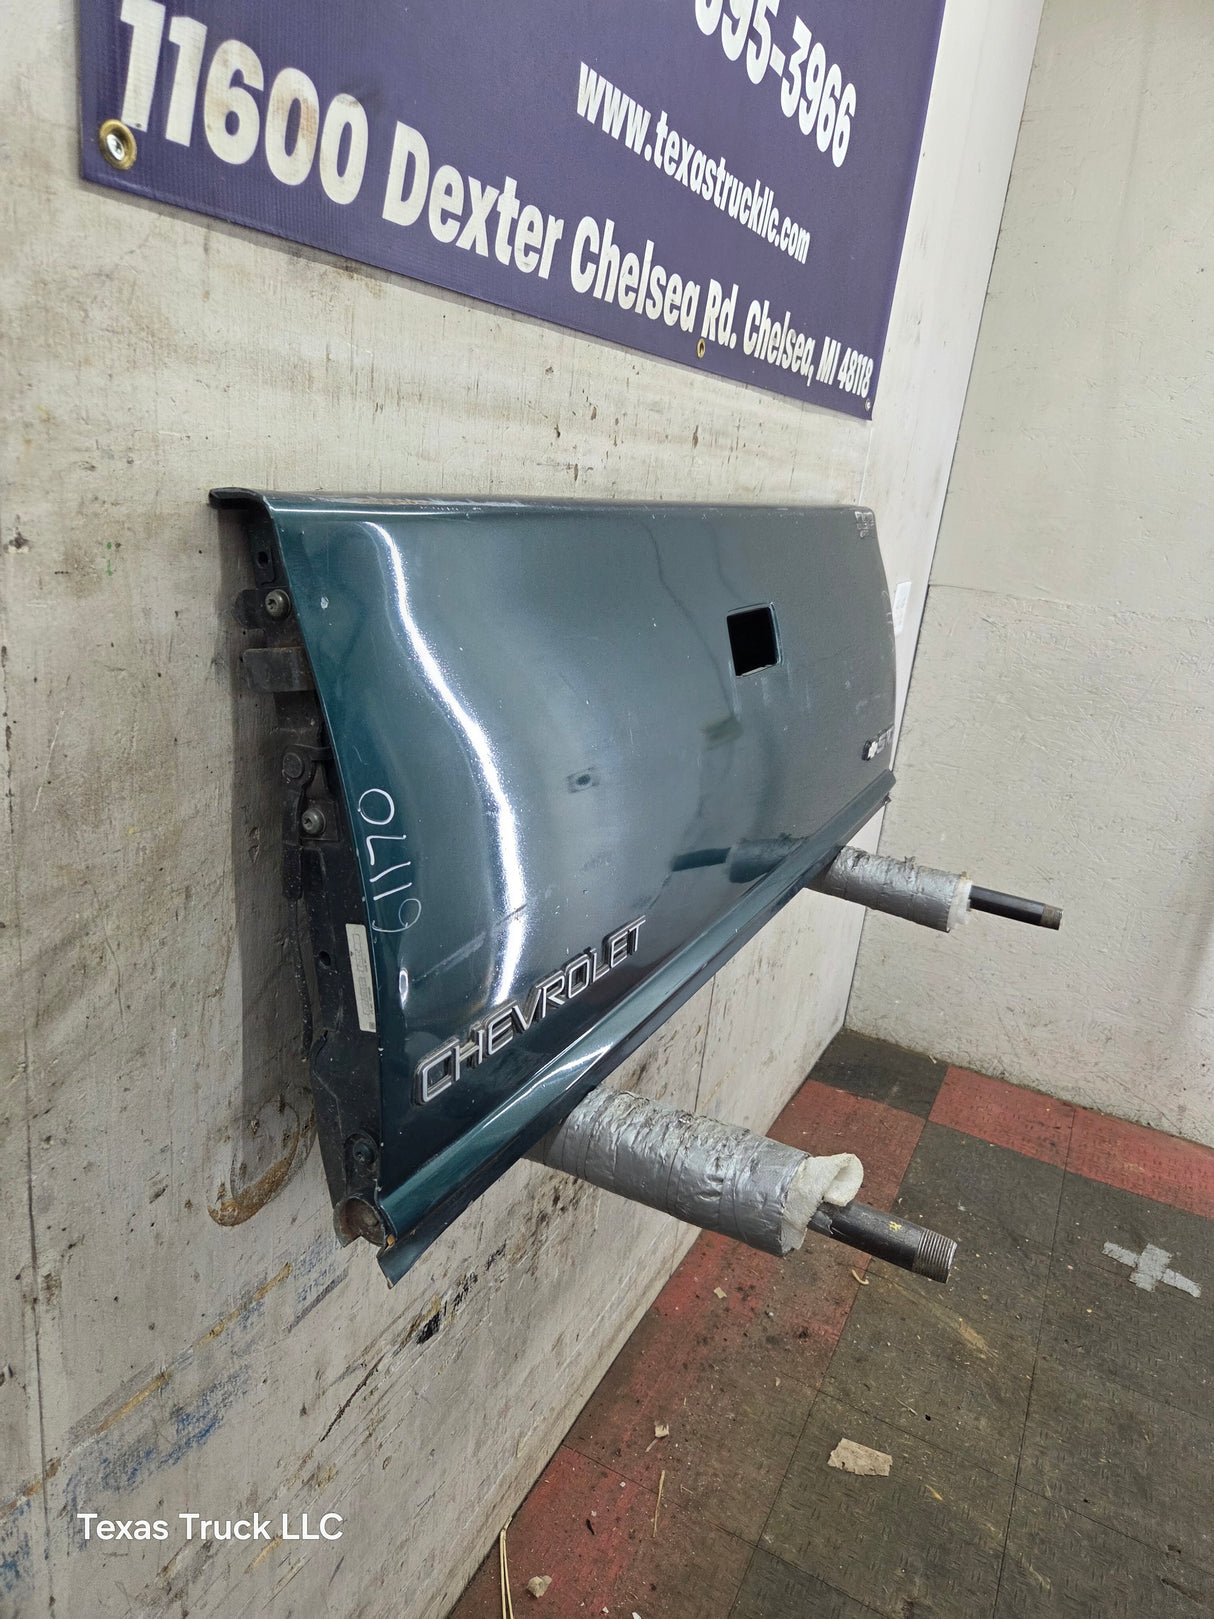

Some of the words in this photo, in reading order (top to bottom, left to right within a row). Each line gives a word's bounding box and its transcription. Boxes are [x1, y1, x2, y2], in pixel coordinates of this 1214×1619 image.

[119, 0, 369, 206] 11600
[381, 120, 565, 280] Dexter
[570, 216, 701, 333] Chelsea
[700, 278, 740, 350] Rd.
[743, 299, 816, 387] Chelsea,
[816, 336, 842, 386] MI
[837, 346, 874, 399] 48118
[576, 61, 811, 265] www.texastruckllc.com
[414, 915, 647, 1105] CHEVROLET
